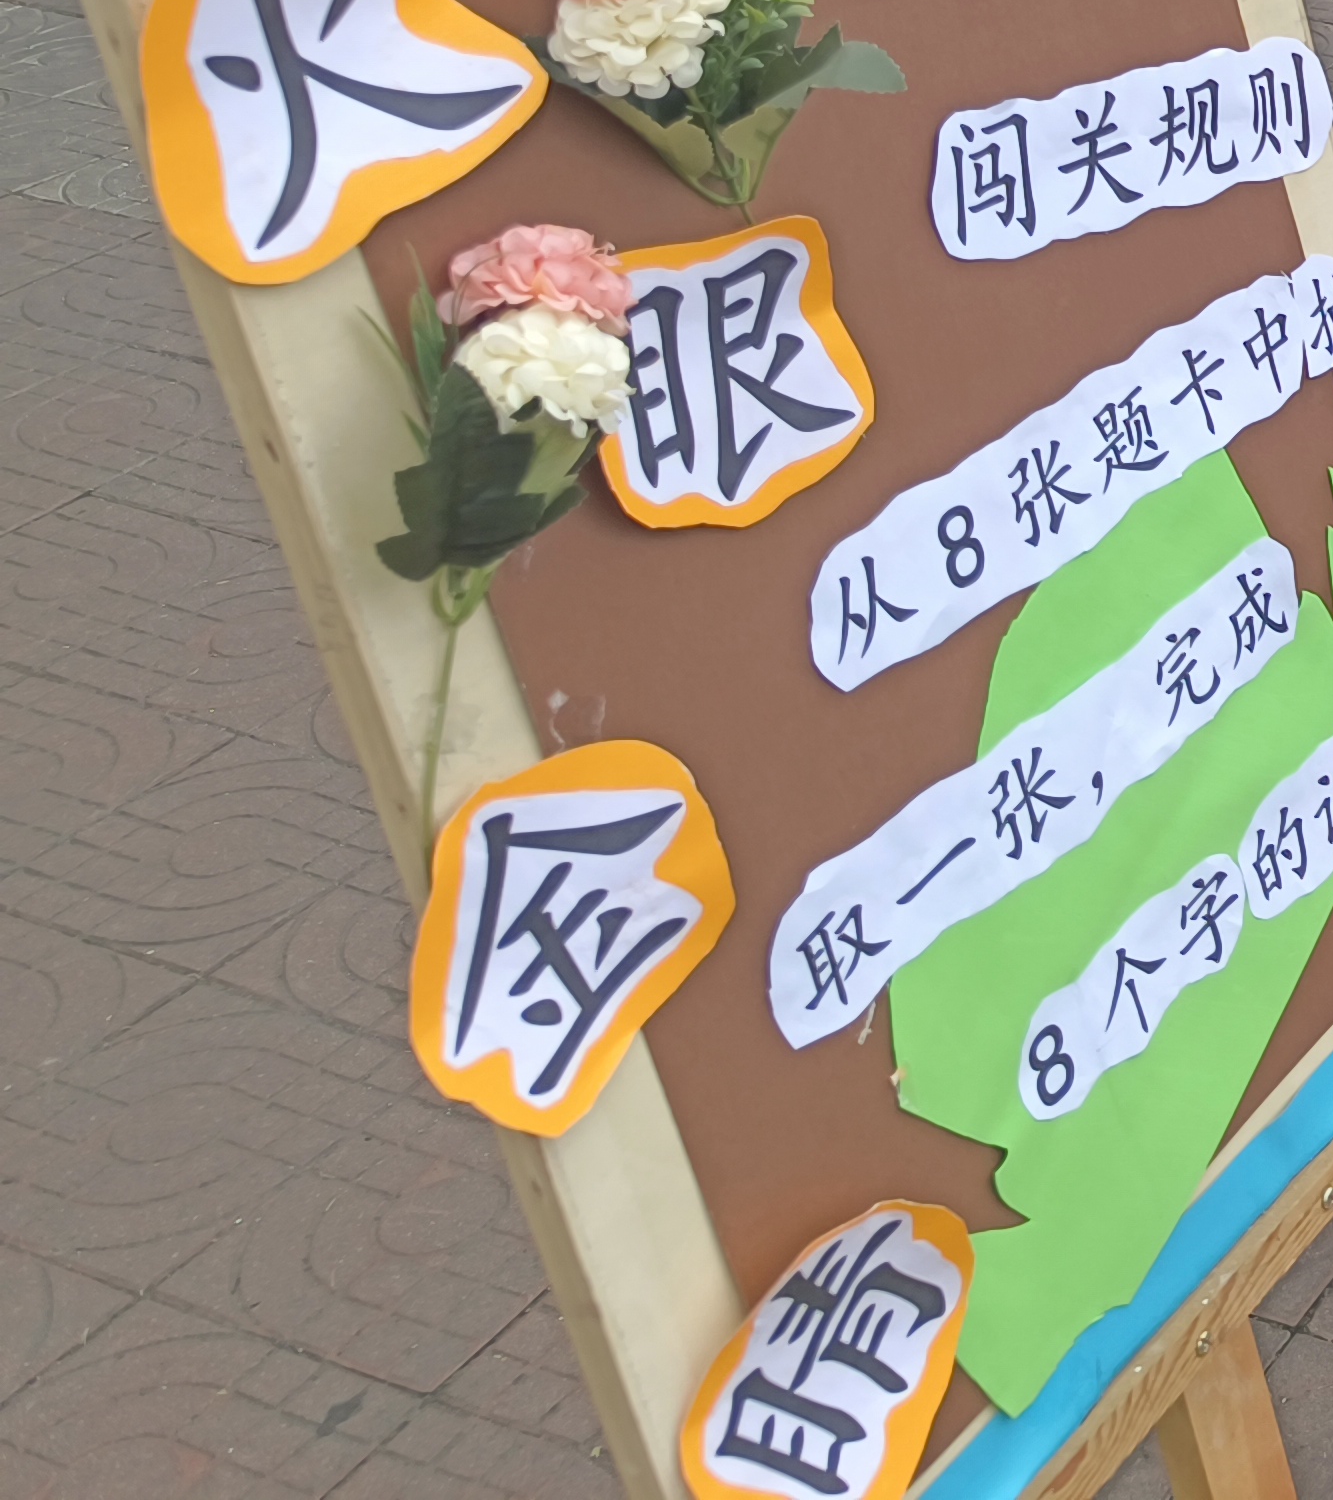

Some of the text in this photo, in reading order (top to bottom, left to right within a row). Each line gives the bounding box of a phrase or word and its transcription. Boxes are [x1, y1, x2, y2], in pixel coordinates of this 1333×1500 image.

[950, 52, 1312, 247] 闯关规则
[795, 566, 1289, 1012] 取一张，完成
